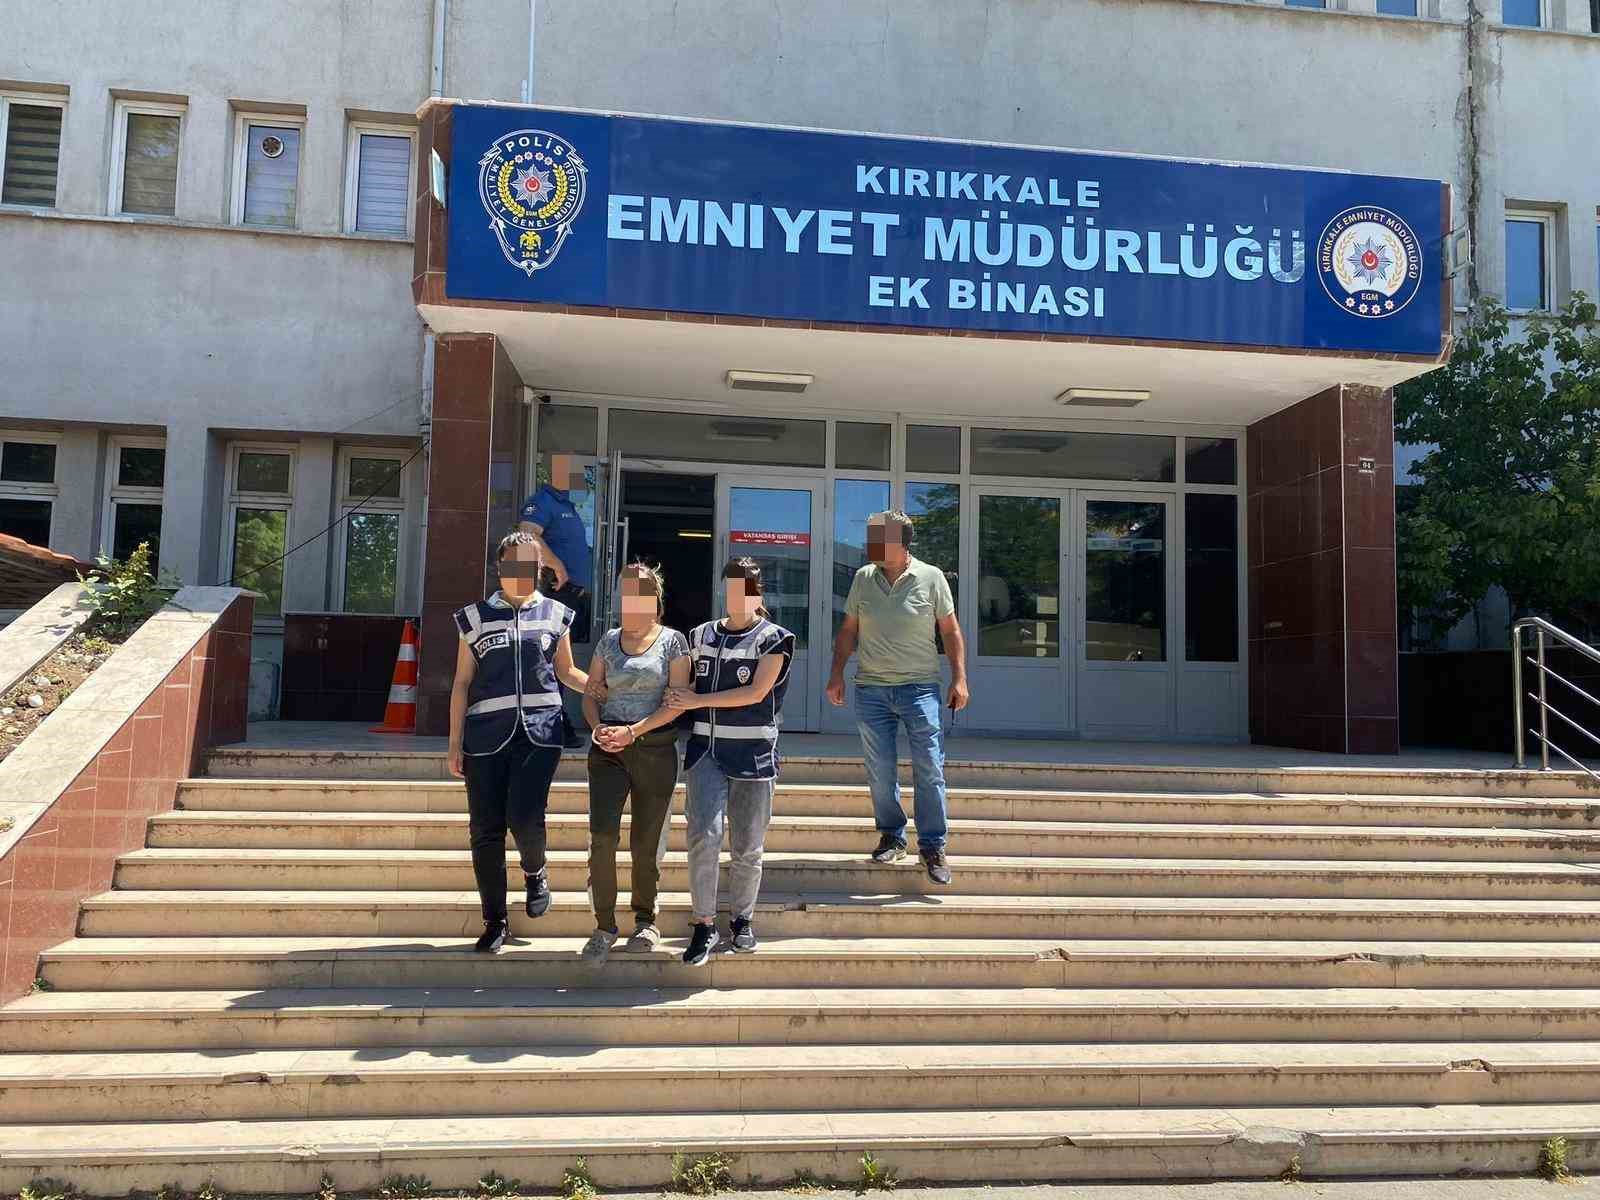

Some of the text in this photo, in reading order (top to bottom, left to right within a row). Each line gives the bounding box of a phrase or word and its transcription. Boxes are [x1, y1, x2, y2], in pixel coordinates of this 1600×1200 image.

[505, 137, 564, 156] POLİS
[856, 164, 1100, 208] KIRIKKALE
[512, 216, 550, 228] GENEL
[924, 209, 1304, 284] MÜDÜRLÜĞÜ
[1323, 223, 1344, 273] KIRIKKALE
[869, 272, 1105, 318] EK BİNASI
[1361, 293, 1379, 301] EGM
